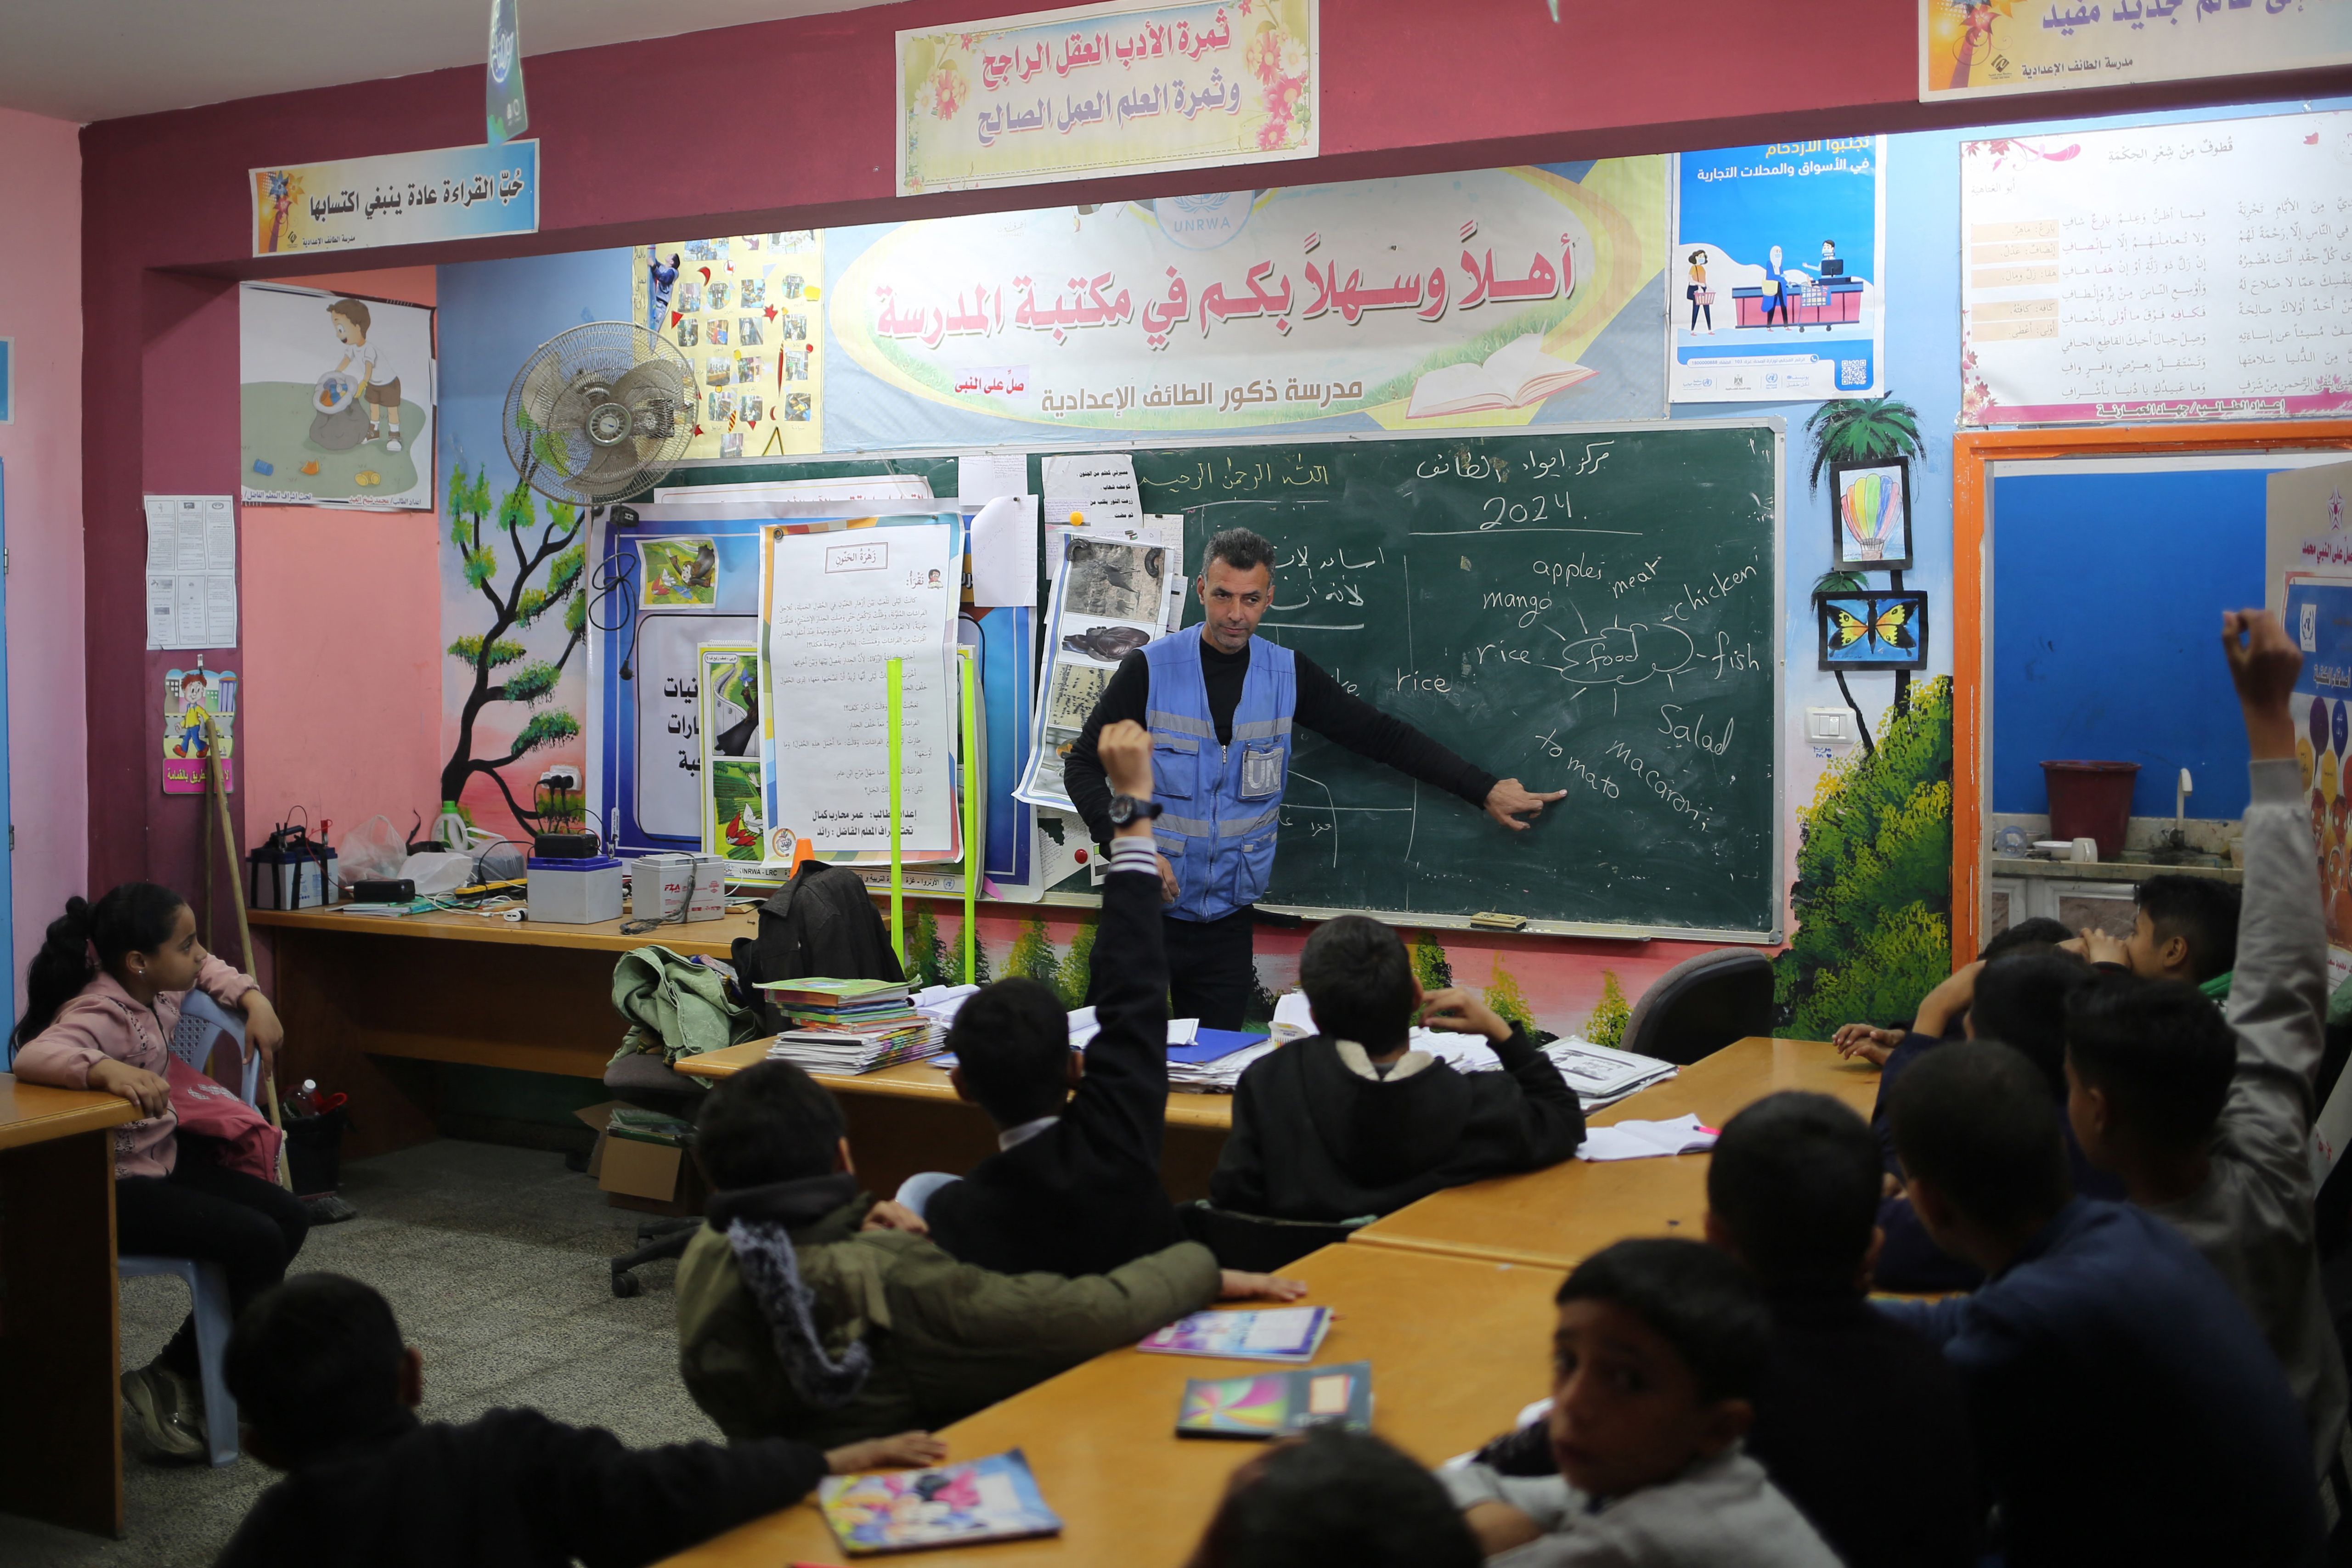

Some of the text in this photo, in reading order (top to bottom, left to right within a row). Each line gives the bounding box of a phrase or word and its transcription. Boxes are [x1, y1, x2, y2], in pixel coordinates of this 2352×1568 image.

[2042, 0, 2100, 37] مفيد
[983, 5, 1232, 91] ثمرة الأدب العقل الراجح
[2021, 63, 2064, 79] الإعدادية
[2068, 60, 2100, 71] الطائف
[2105, 57, 2132, 69] مدرسة
[977, 67, 1241, 147] وثمرة العلم العمل الصالح
[1698, 157, 1870, 182] في الأسواق والمحلات التجارية
[408, 184, 437, 206] عادة
[444, 176, 494, 207] القراءة
[310, 191, 359, 222] اكتسابها
[365, 186, 402, 220] ينبغي
[2180, 209, 2205, 220] فيما
[1174, 217, 1230, 232] UNRWA
[2336, 225, 2348, 241] في
[342, 235, 355, 243] مدرسة
[2163, 261, 2173, 273] ذو
[2285, 277, 2293, 287] لا
[1013, 271, 1133, 346] مكتبة
[1145, 264, 1191, 351] في
[1197, 258, 1294, 341] بكم
[874, 281, 1004, 342] المدرسة
[2129, 311, 2140, 320] ما
[2062, 337, 2094, 354] الجافي
[2276, 332, 2290, 342] عن
[984, 379, 1003, 394] على
[2142, 384, 2149, 395] يا
[1040, 378, 1364, 425] مدرسة ذكور الطائف الإعدادية
[2159, 402, 2189, 417] جهاد
[1576, 439, 1615, 476] مركز
[1138, 462, 1213, 493] الرحيم
[1479, 491, 1572, 530] 2024
[2302, 542, 2316, 555] محمد
[1483, 591, 1553, 629] mango
[1476, 640, 1532, 665] rice
[1586, 632, 1638, 673] food
[1711, 631, 1760, 680] fish
[1397, 667, 1452, 693] rice
[1248, 758, 1281, 789] UN
[813, 810, 827, 821] كمال
[851, 812, 863, 821] عمر
[837, 827, 859, 837] الفاضل
[862, 827, 876, 837] المعلم
[766, 867, 778, 876] LRC
[905, 877, 916, 888] غزة
